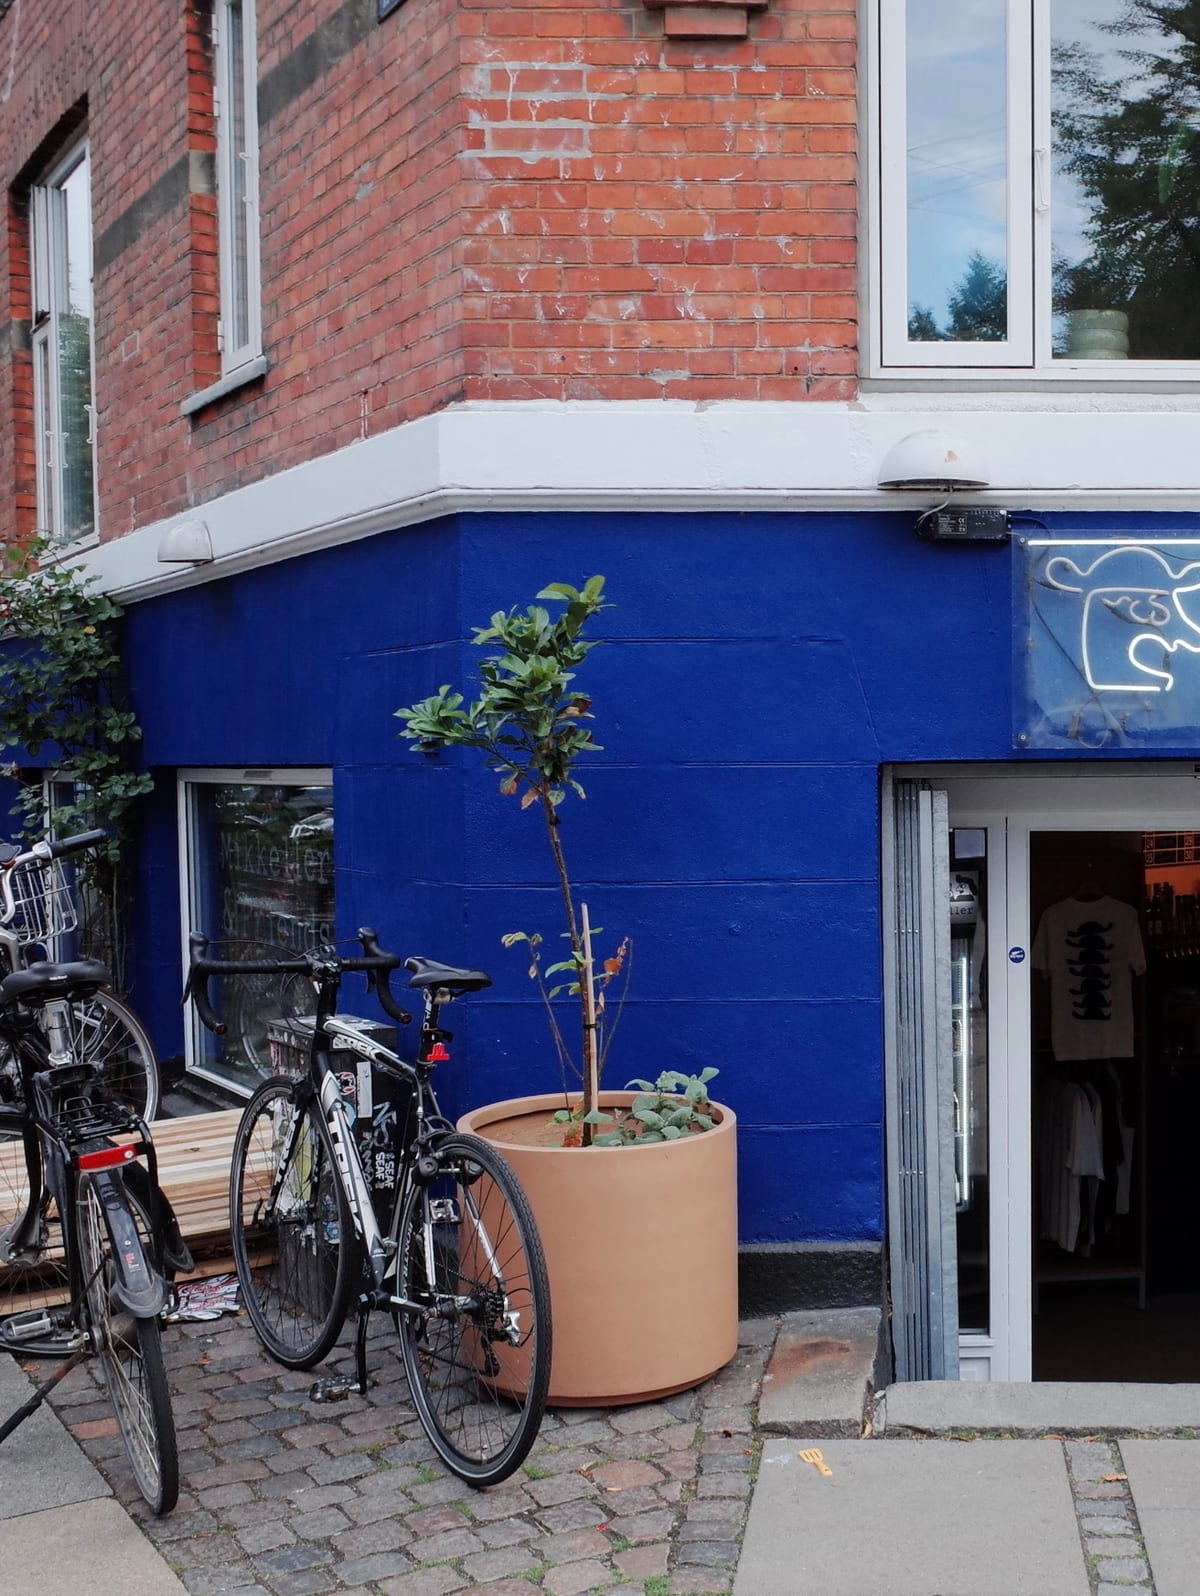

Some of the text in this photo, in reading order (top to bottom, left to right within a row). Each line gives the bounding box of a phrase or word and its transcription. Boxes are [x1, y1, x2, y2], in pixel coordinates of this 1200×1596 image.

[375, 1151, 385, 1181] SEAF
[385, 1161, 395, 1190] SEAF
[402, 1221, 414, 1326] BONTRAGR
